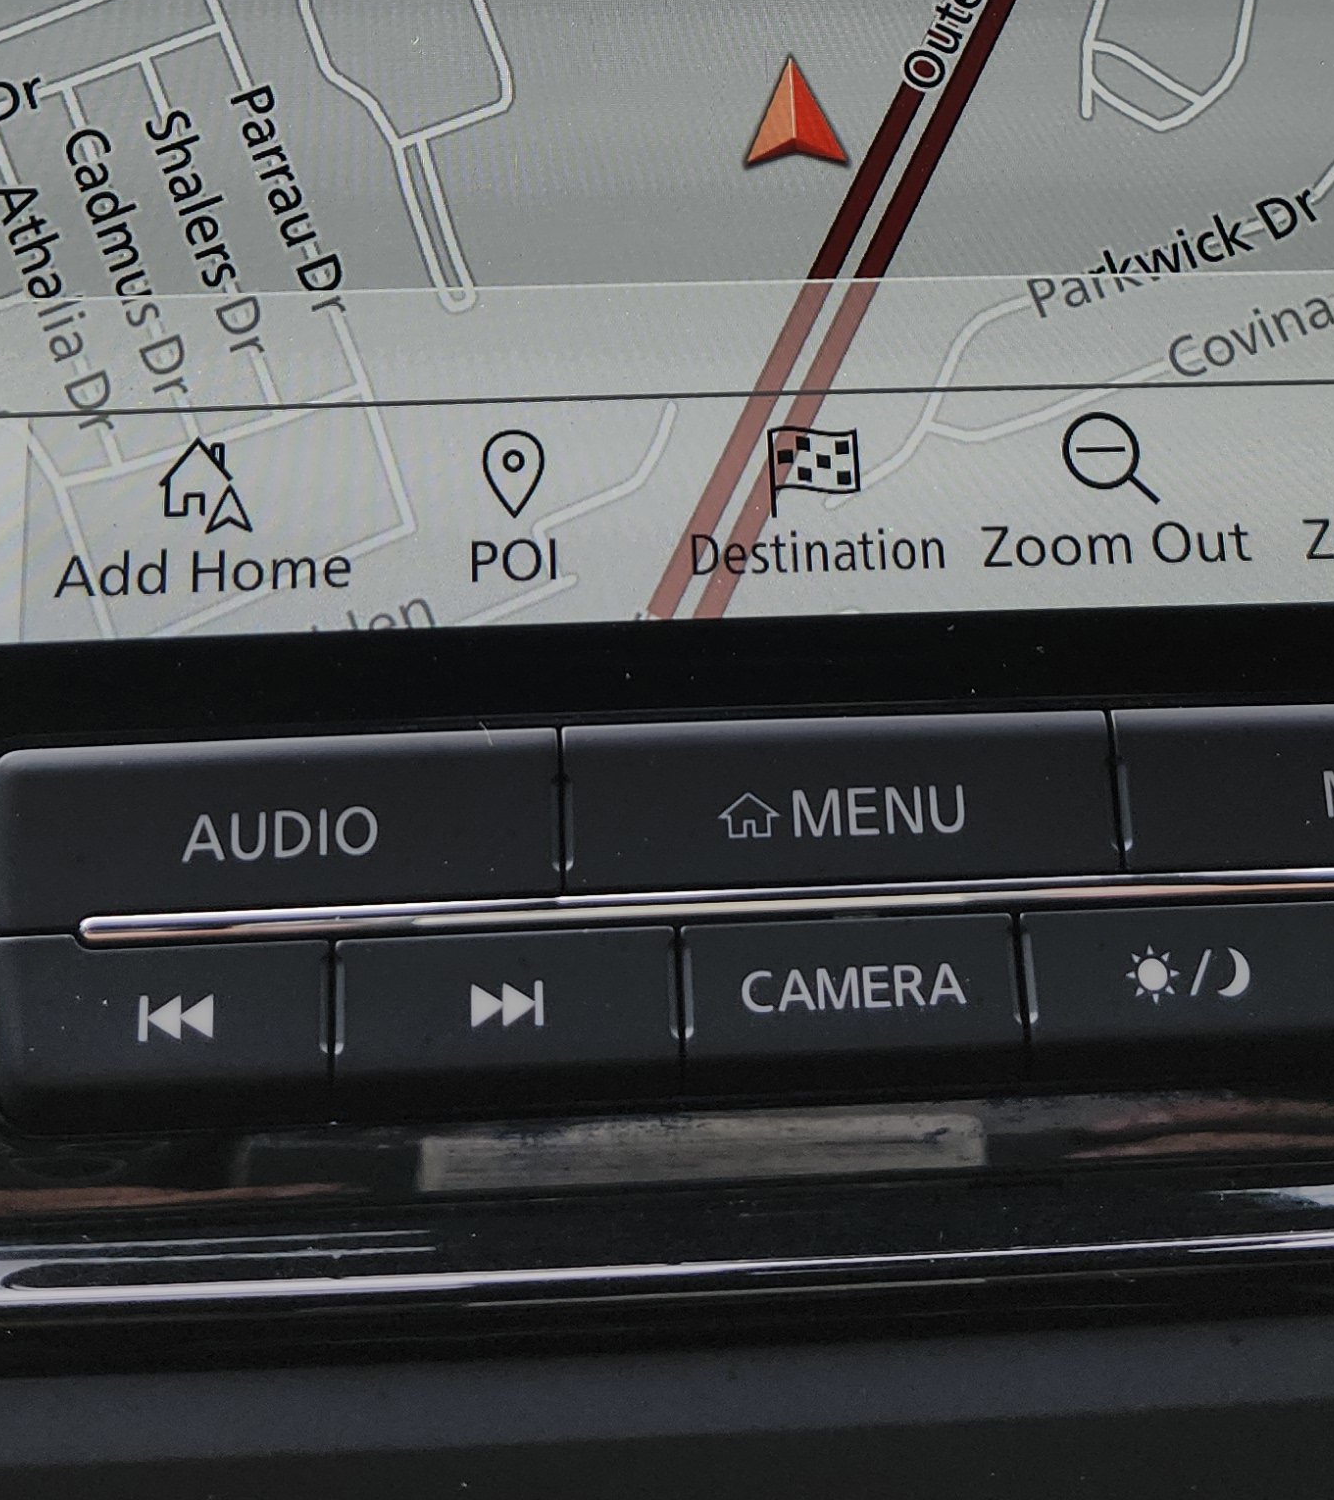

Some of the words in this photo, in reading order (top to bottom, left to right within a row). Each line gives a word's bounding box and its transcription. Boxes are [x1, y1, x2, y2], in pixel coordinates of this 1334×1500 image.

[231, 85, 317, 247] Parrau
[296, 253, 346, 312] Dr
[146, 110, 237, 287] Shalers
[216, 296, 264, 353] Dr
[1027, 213, 1255, 318] Parkwick
[1255, 188, 1317, 240] Dr
[67, 128, 160, 328] Cadmus
[139, 334, 188, 394] Dr
[64, 370, 114, 430] Dr
[55, 551, 168, 597] Add
[191, 550, 352, 594] Home
[470, 538, 558, 582] POI
[691, 530, 946, 575] Destination
[981, 525, 1133, 569] Zoom
[1153, 522, 1252, 563] Out
[181, 805, 379, 863] AUDIO
[790, 784, 968, 840] MENU
[740, 963, 967, 1016] CAMERA
